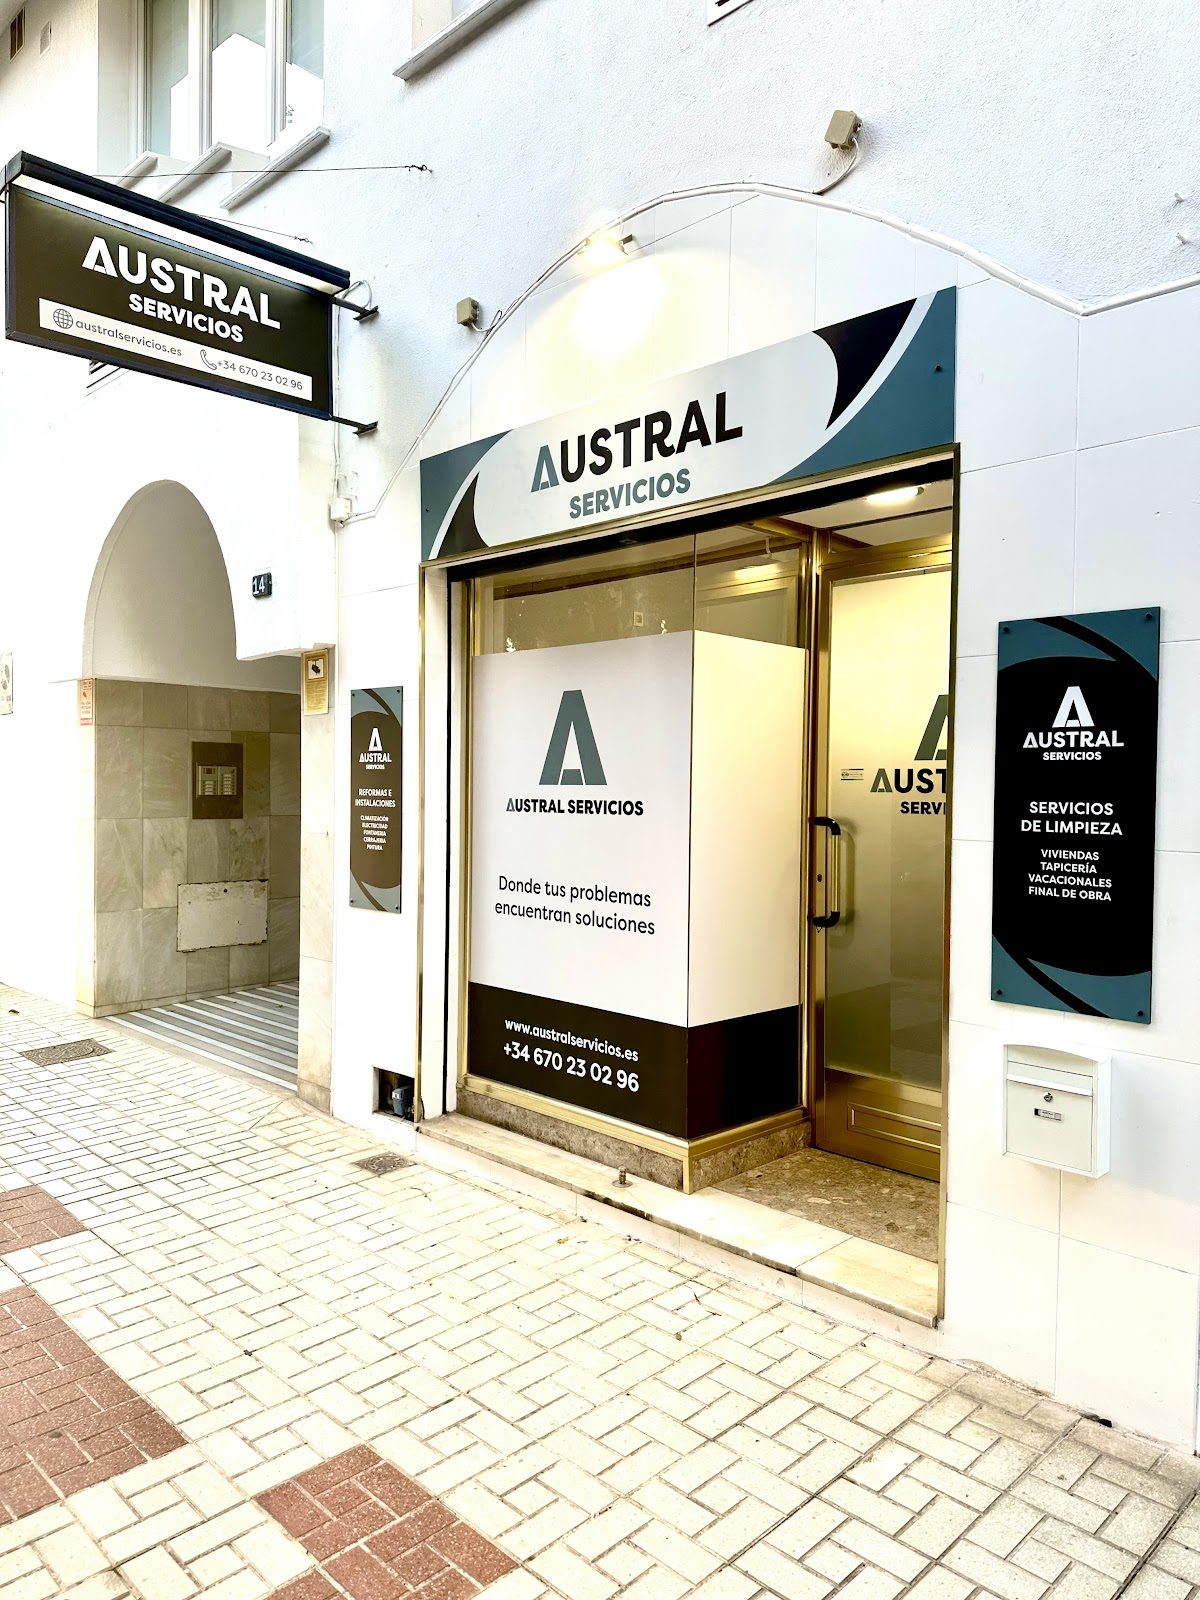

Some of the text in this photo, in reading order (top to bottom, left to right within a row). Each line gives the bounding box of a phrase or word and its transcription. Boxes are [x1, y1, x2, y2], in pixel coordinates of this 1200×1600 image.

[82, 236, 281, 329] AUSTRAL
[129, 293, 244, 343] SERVICIOS
[75, 320, 182, 356] australservicios.es
[217, 360, 303, 390] +34 670 23 02 96
[531, 391, 743, 493] AUSTRAL
[569, 468, 691, 519] SERVICIOS
[252, 576, 265, 595] 14
[1052, 686, 1095, 728] A
[539, 689, 608, 785] A
[1022, 730, 1125, 749] AUSTRAL
[359, 752, 392, 763] AUSTRAL
[1042, 751, 1102, 761] SERVICIOS
[358, 788, 392, 797] REFORMAS E
[355, 799, 396, 808] INSTALACIONES
[506, 798, 644, 816] AUSTRAL SERVICIOS
[1029, 801, 1114, 816] SERVICIOS
[1021, 819, 1123, 836] DE LIMPIEZA
[1041, 849, 1100, 861] VIVIENDAS
[1040, 861, 1097, 874] TAPICERÍA
[1028, 873, 1112, 888] VACACIONALES
[499, 875, 651, 907] Donde tus problemas
[1028, 886, 1112, 901] FINAL DE OBRA
[495, 902, 655, 935] encuentran soluciones
[504, 1019, 639, 1062] www.australservicios.es
[503, 1041, 640, 1092] +34 670 23 02 96
